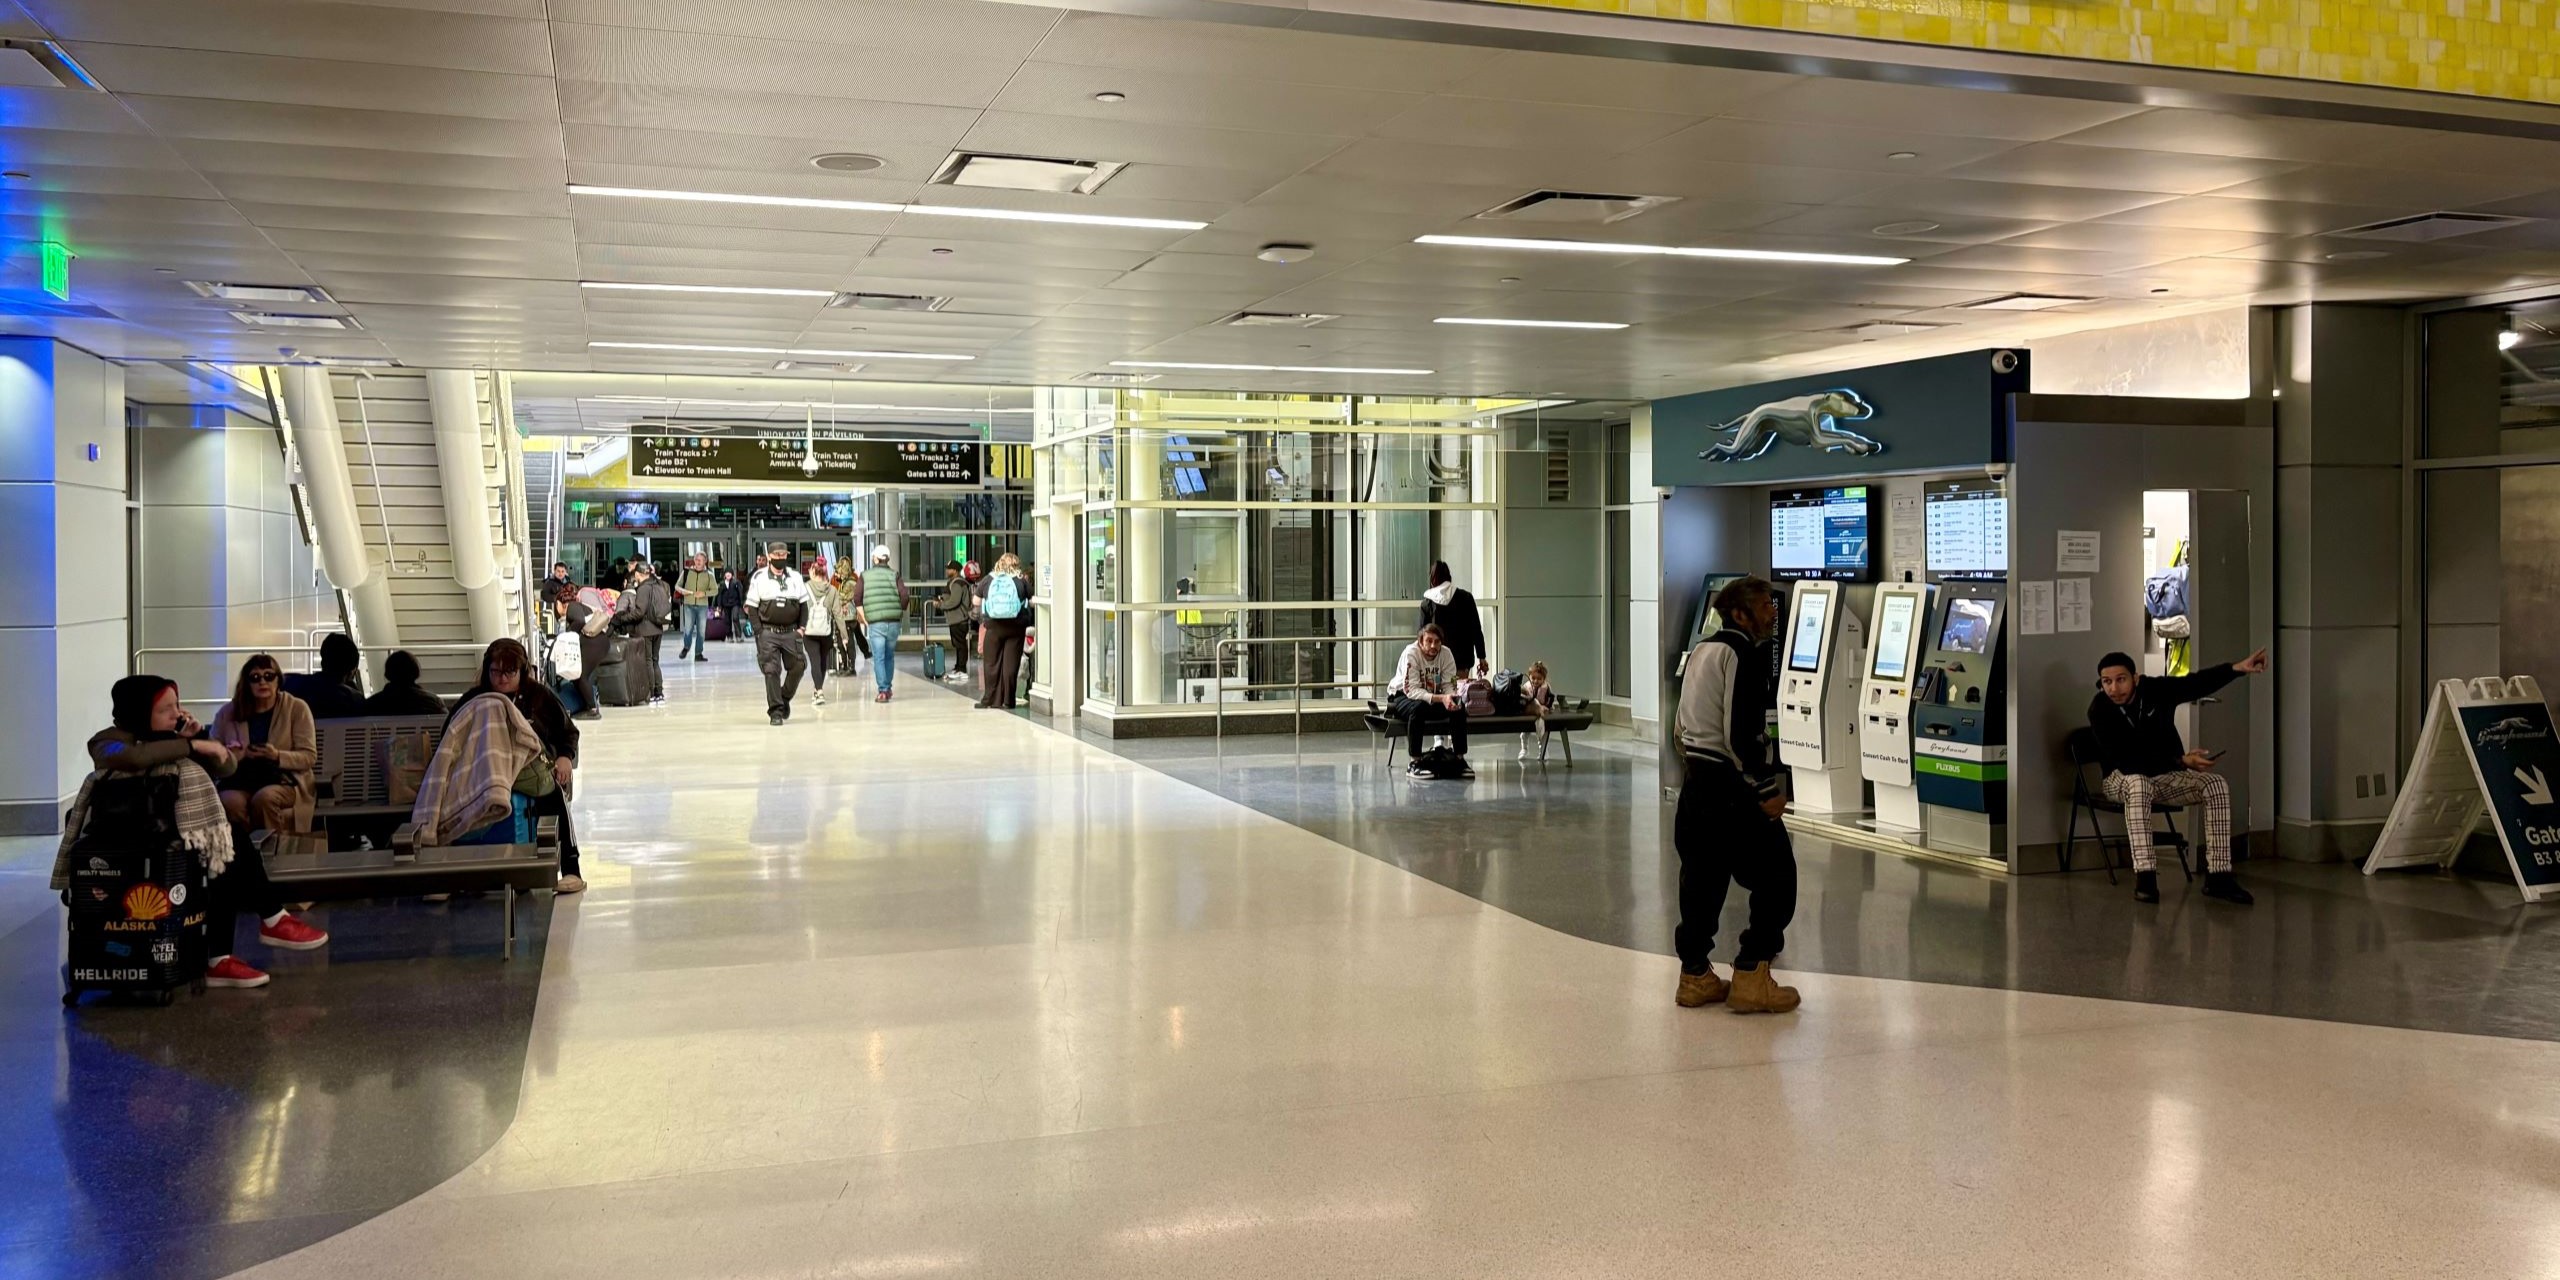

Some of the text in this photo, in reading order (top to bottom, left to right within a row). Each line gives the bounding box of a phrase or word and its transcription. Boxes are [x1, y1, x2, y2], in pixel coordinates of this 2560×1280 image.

[757, 429, 864, 439] UNION STATIN PAVILION
[654, 449, 674, 457] Train
[675, 449, 700, 457] Tracks
[701, 449, 707, 457] 2
[713, 449, 718, 457] 7
[769, 451, 804, 459] Train Hall
[833, 452, 853, 460] Track
[855, 452, 859, 460] 1
[654, 458, 688, 466] Gate B21
[955, 454, 960, 462] 7
[769, 459, 796, 467] Amtrak
[824, 461, 857, 470] Ticketing
[932, 462, 949, 470] Gate
[654, 466, 685, 474] Elevator
[696, 467, 715, 475] Train
[717, 467, 732, 475] Hall
[906, 470, 927, 478] Gates
[1930, 742, 1968, 754] Greyhound
[1862, 751, 1879, 760] Convert
[1936, 762, 1960, 773] FLIXBUS
[2533, 851, 2553, 866] B3
[104, 921, 156, 931] ALASKA
[74, 968, 148, 980] HELLRIDE
